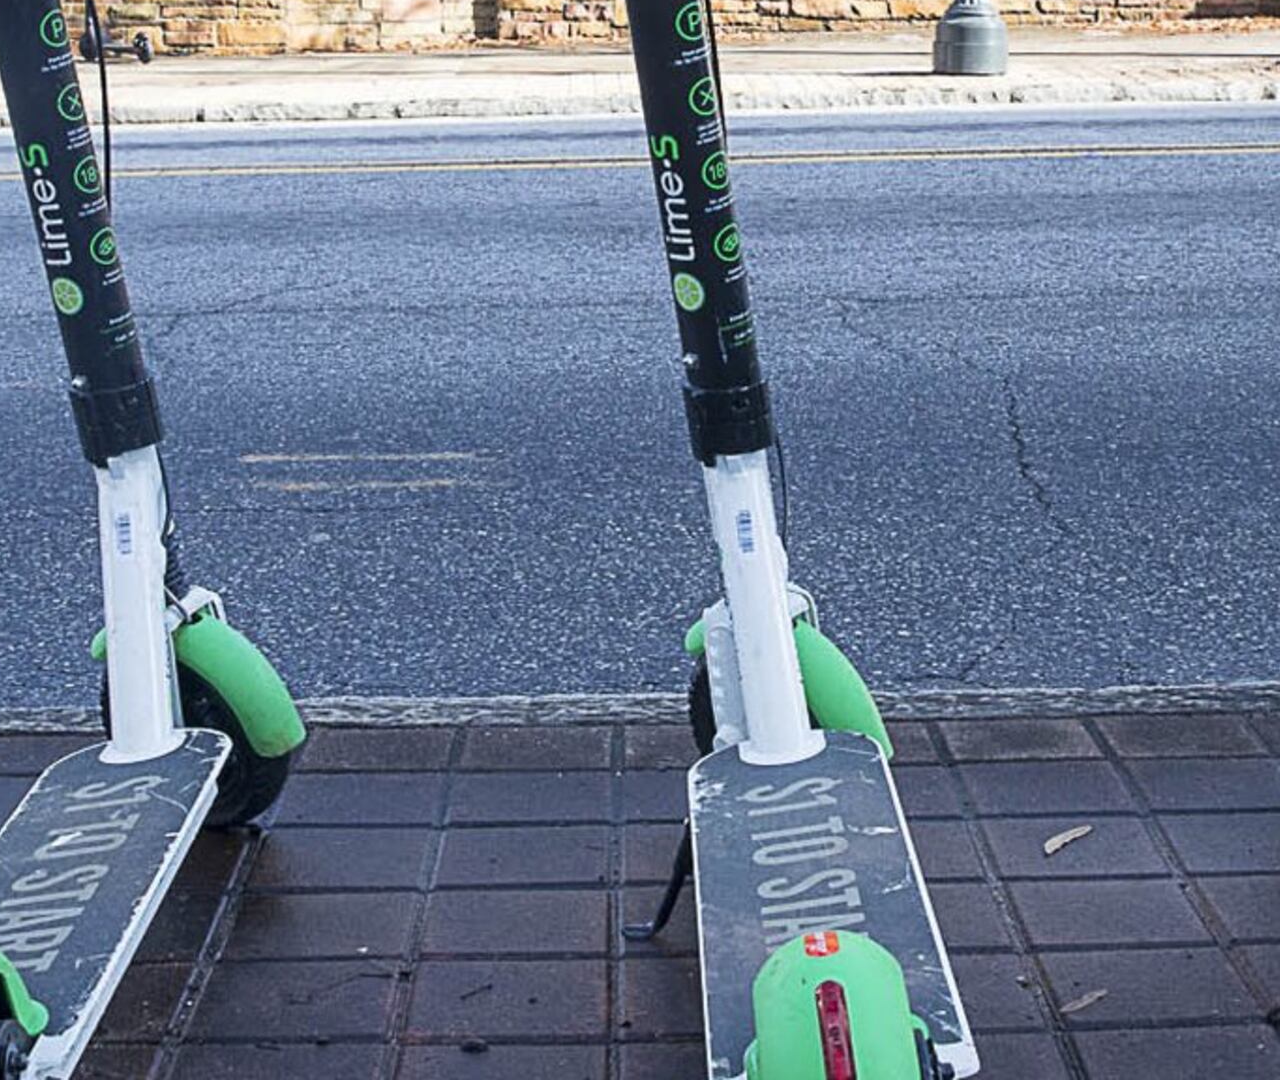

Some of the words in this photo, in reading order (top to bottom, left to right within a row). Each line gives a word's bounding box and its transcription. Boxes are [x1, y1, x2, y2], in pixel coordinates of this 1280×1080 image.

[20, 142, 73, 266] Lime-S
[651, 135, 695, 262] Lime-S
[736, 777, 843, 817] $1
[34, 811, 140, 862] TO
[751, 815, 849, 866] TO
[757, 868, 868, 951] STA
